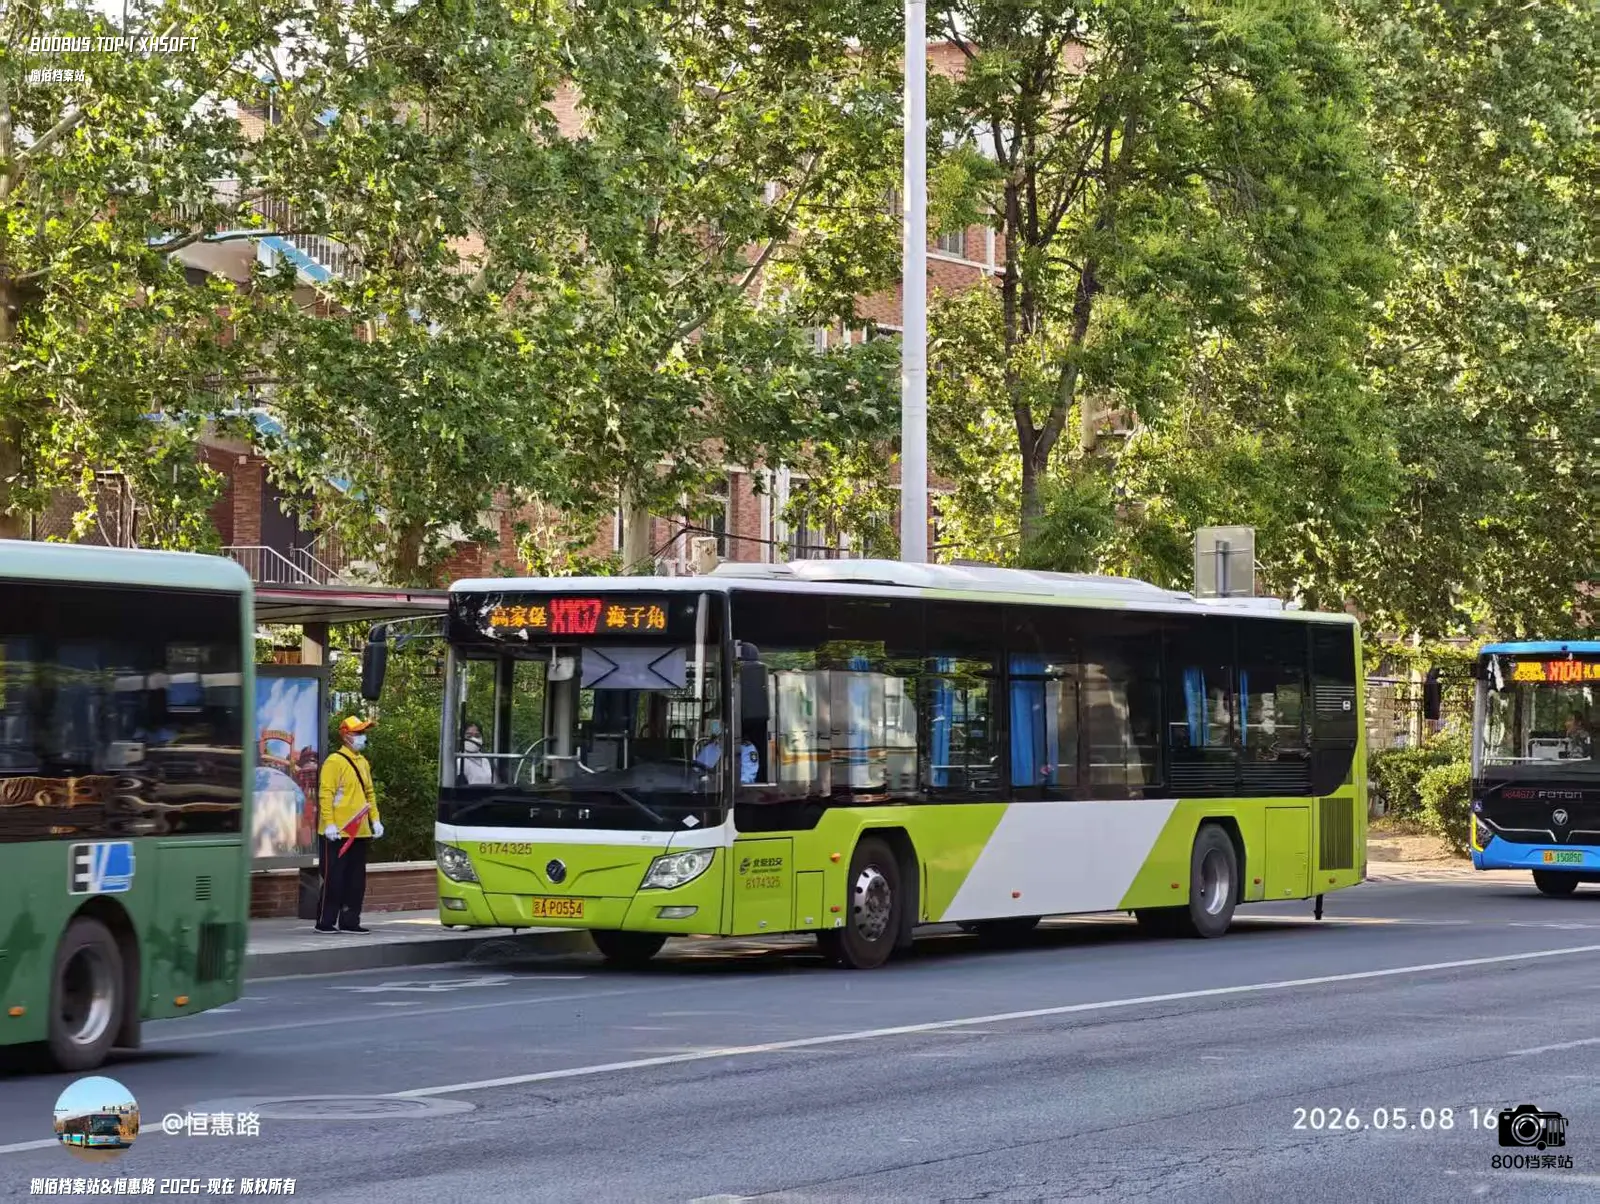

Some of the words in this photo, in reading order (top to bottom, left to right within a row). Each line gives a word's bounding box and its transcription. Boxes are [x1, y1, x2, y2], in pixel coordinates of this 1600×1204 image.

[606, 605, 666, 629] 海子角
[1538, 790, 1582, 799] FOTON
[479, 842, 533, 855] 6174325
